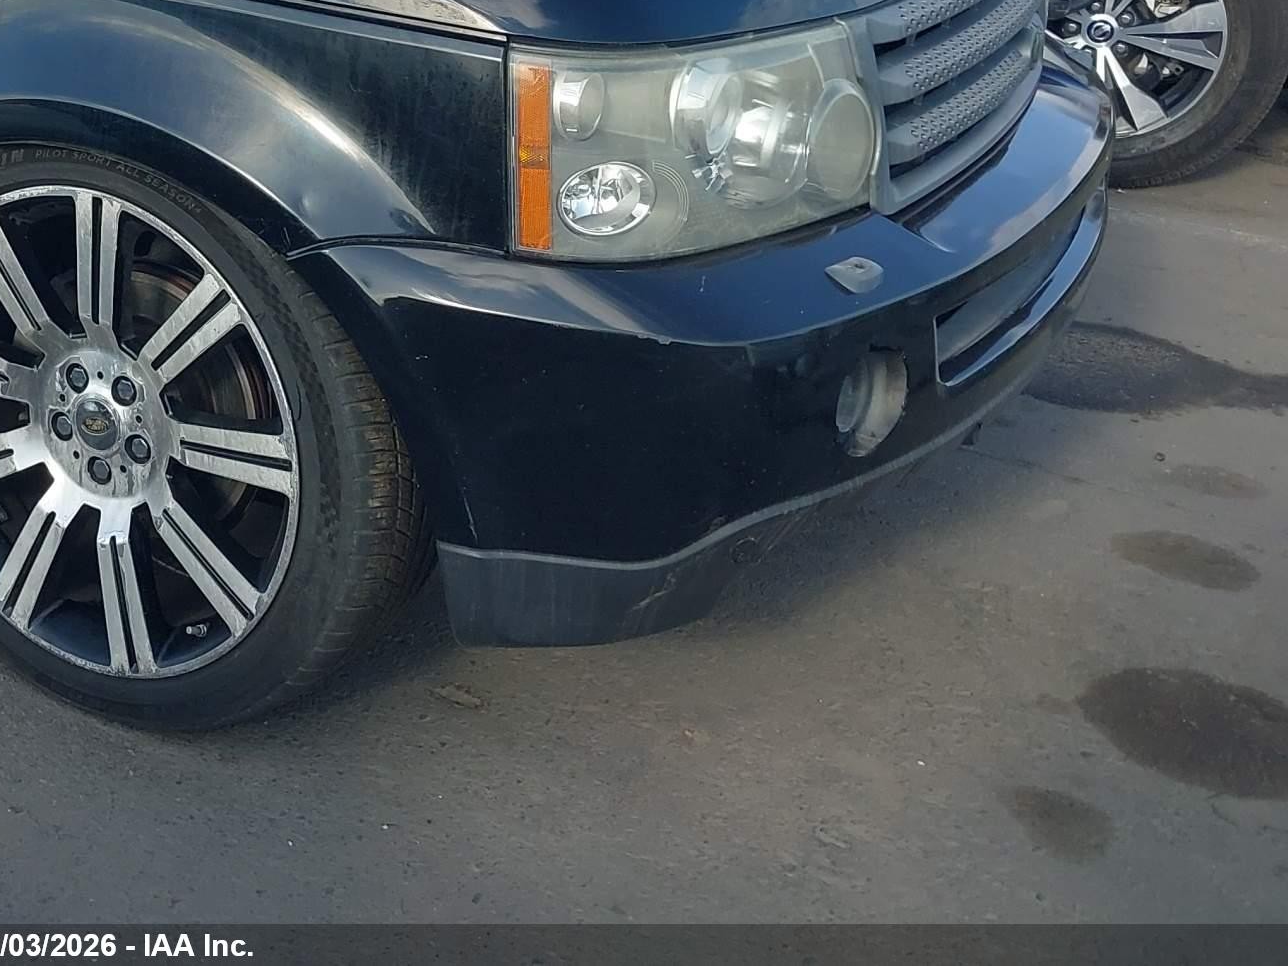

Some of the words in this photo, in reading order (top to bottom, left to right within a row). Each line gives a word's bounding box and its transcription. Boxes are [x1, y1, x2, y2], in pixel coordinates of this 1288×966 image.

[35, 148, 69, 159] PILOT
[72, 151, 111, 167] SPORT
[115, 164, 140, 179] ALL
[143, 174, 196, 210] SEASON
